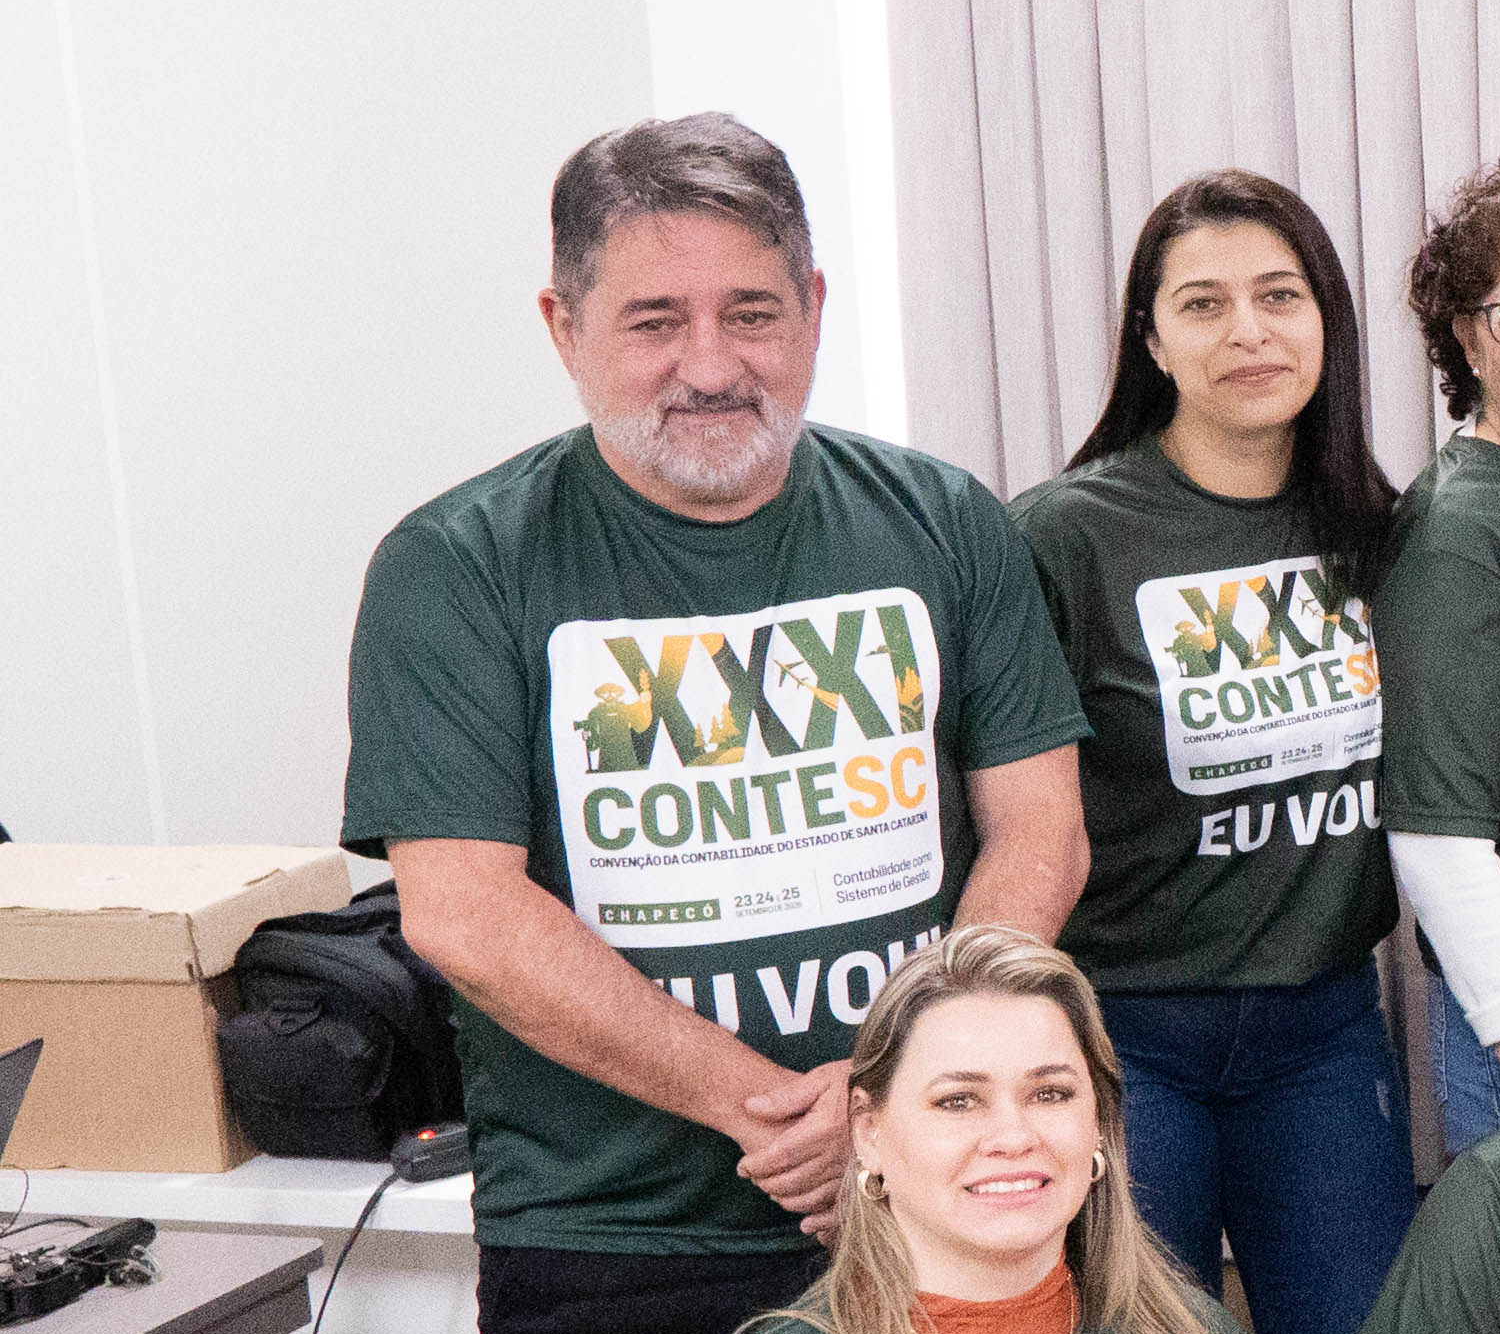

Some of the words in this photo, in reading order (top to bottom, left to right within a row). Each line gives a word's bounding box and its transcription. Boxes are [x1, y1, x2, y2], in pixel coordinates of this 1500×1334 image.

[590, 604, 926, 774] XXXI
[583, 746, 926, 851] CONTESC
[1197, 803, 1275, 856] EU
[1287, 780, 1383, 846] VOU
[590, 853, 661, 870] CONVENÇÃO
[663, 853, 680, 866] DA
[681, 842, 776, 865] CONTABILIDADE
[777, 840, 794, 853] DO
[795, 832, 839, 850] ESTADO
[840, 829, 855, 841] DE
[855, 821, 890, 839] SANTA
[833, 860, 911, 887] Contabilidade
[836, 883, 888, 904] Sistema
[888, 878, 902, 892] de
[603, 903, 714, 922] CHAPECÓ
[734, 894, 753, 908] 23
[756, 891, 774, 905] 24
[781, 887, 800, 900] 25
